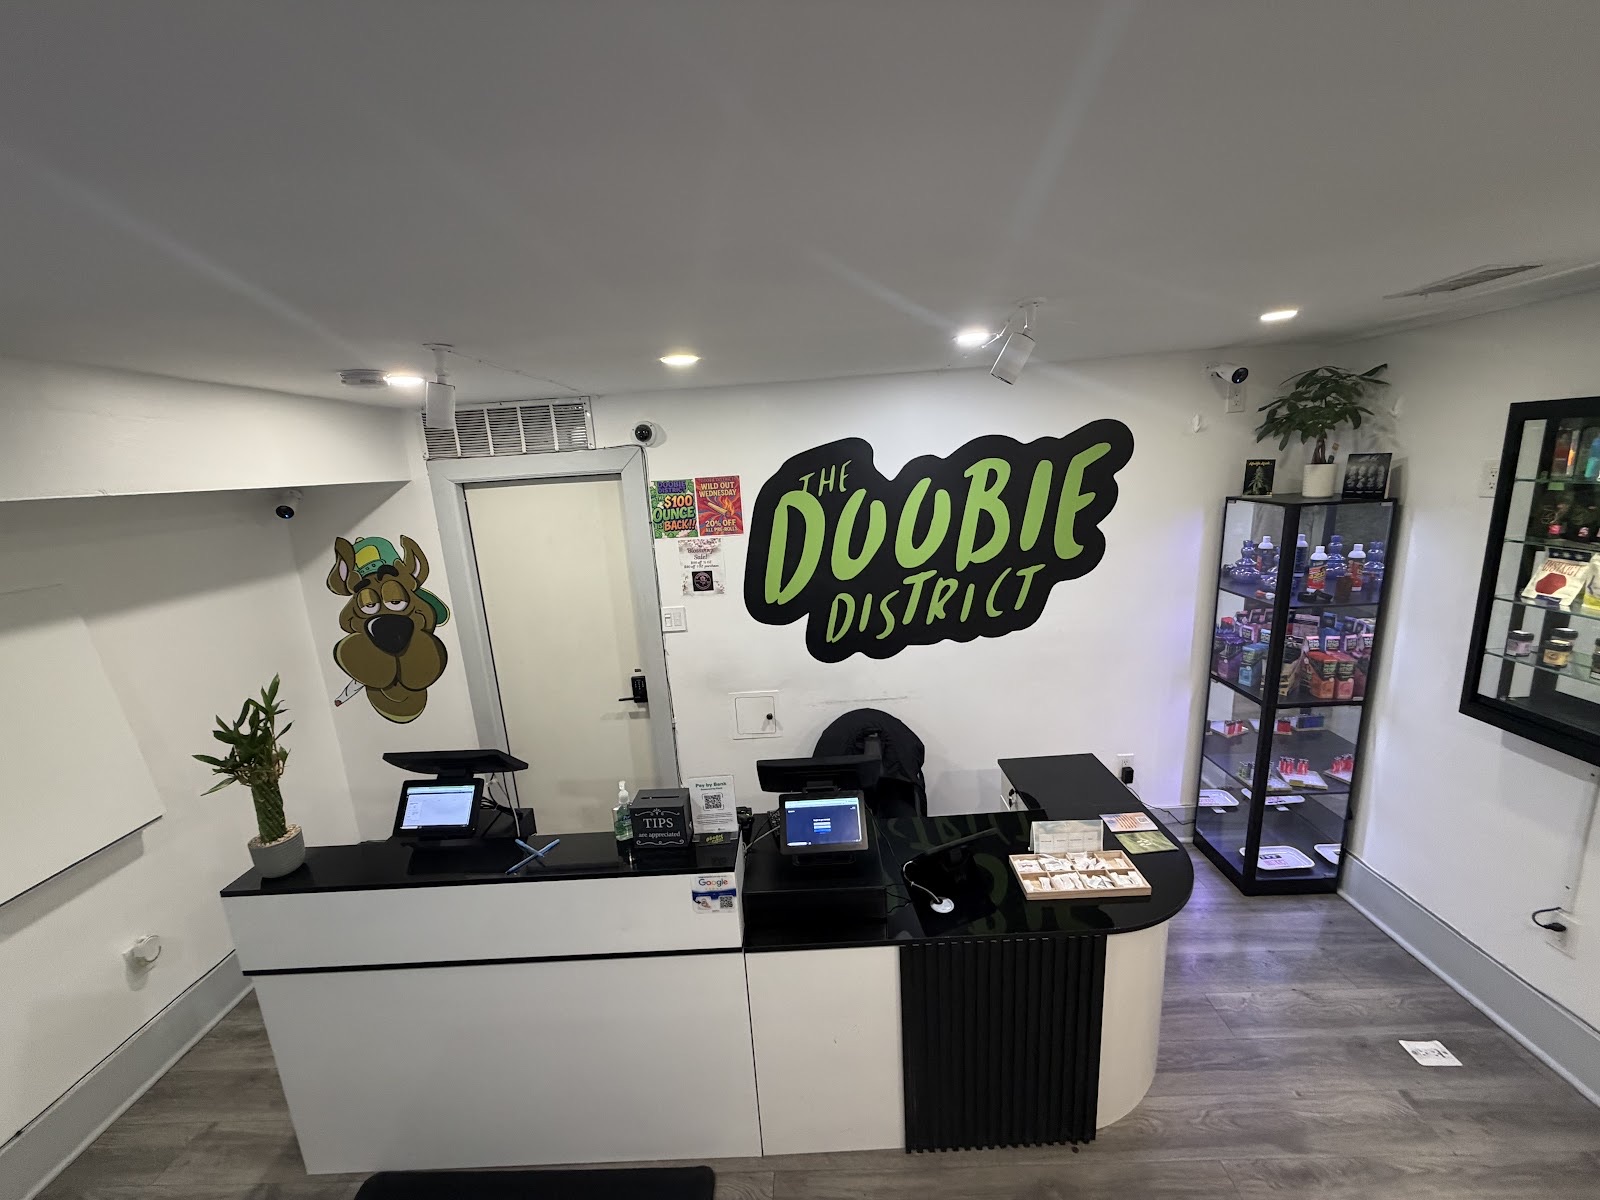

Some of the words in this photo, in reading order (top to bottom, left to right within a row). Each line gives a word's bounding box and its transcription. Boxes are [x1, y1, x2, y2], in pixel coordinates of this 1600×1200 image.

[798, 459, 853, 497] THE
[658, 480, 686, 488] DOOBIE
[700, 482, 718, 490] WILD
[699, 489, 737, 498] WEDNESDAY
[664, 494, 693, 508] $100
[653, 506, 695, 522] OUNCE
[664, 520, 697, 532] BACK!!
[706, 520, 722, 528] 20%
[764, 442, 1112, 606] DOOBIE
[825, 563, 1046, 644] DISTRICT
[642, 818, 674, 828] TIPS
[698, 878, 728, 887] Google
